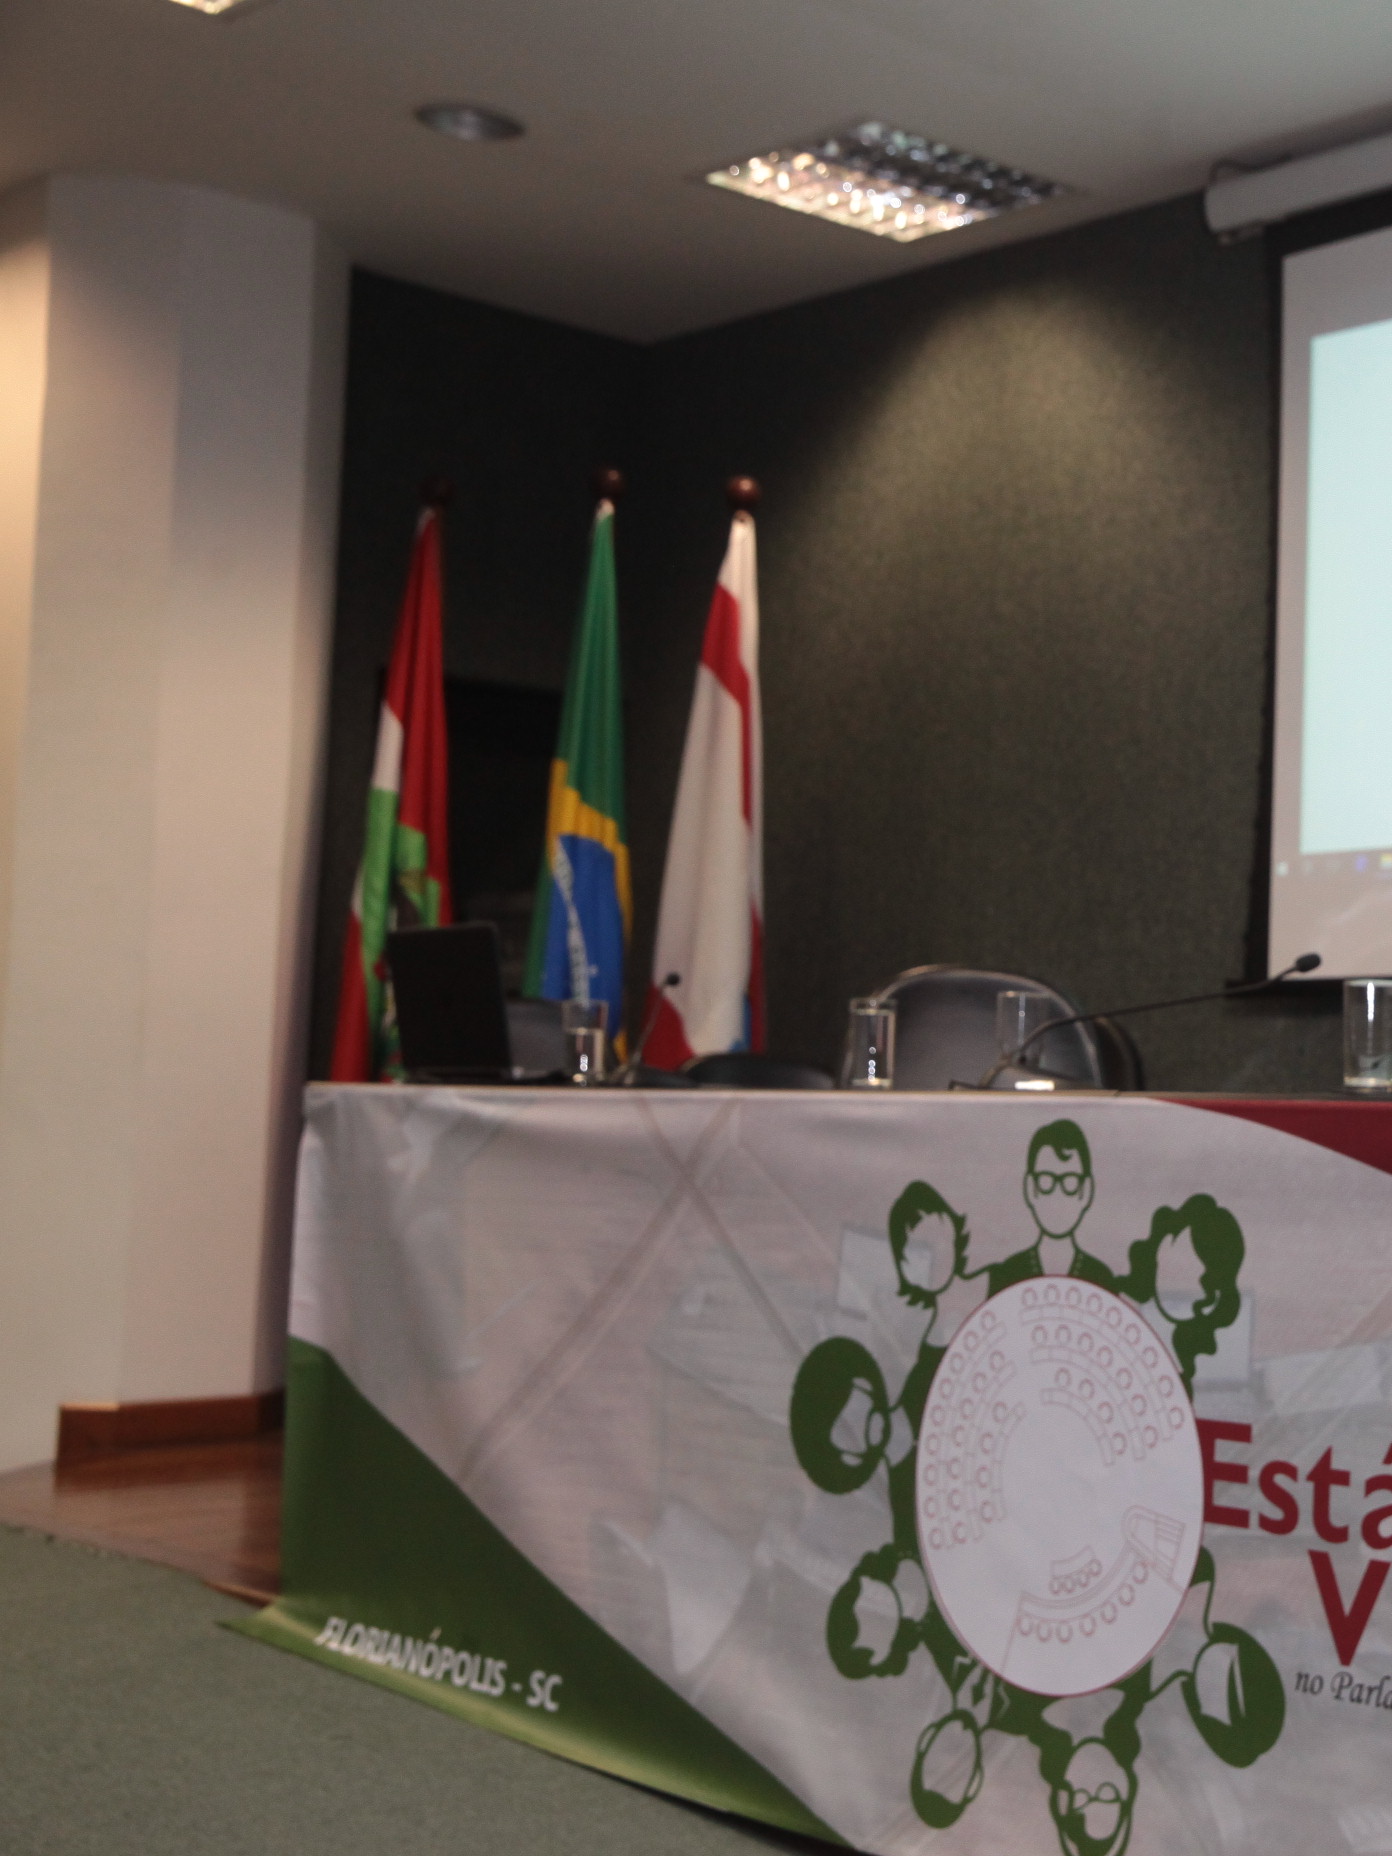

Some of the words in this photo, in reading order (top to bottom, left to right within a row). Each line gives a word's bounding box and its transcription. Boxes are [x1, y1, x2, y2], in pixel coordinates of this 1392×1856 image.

[314, 1616, 508, 1698] FLORIANÓPOLIS
[524, 1669, 563, 1713] SC
[1294, 1670, 1324, 1695] no
